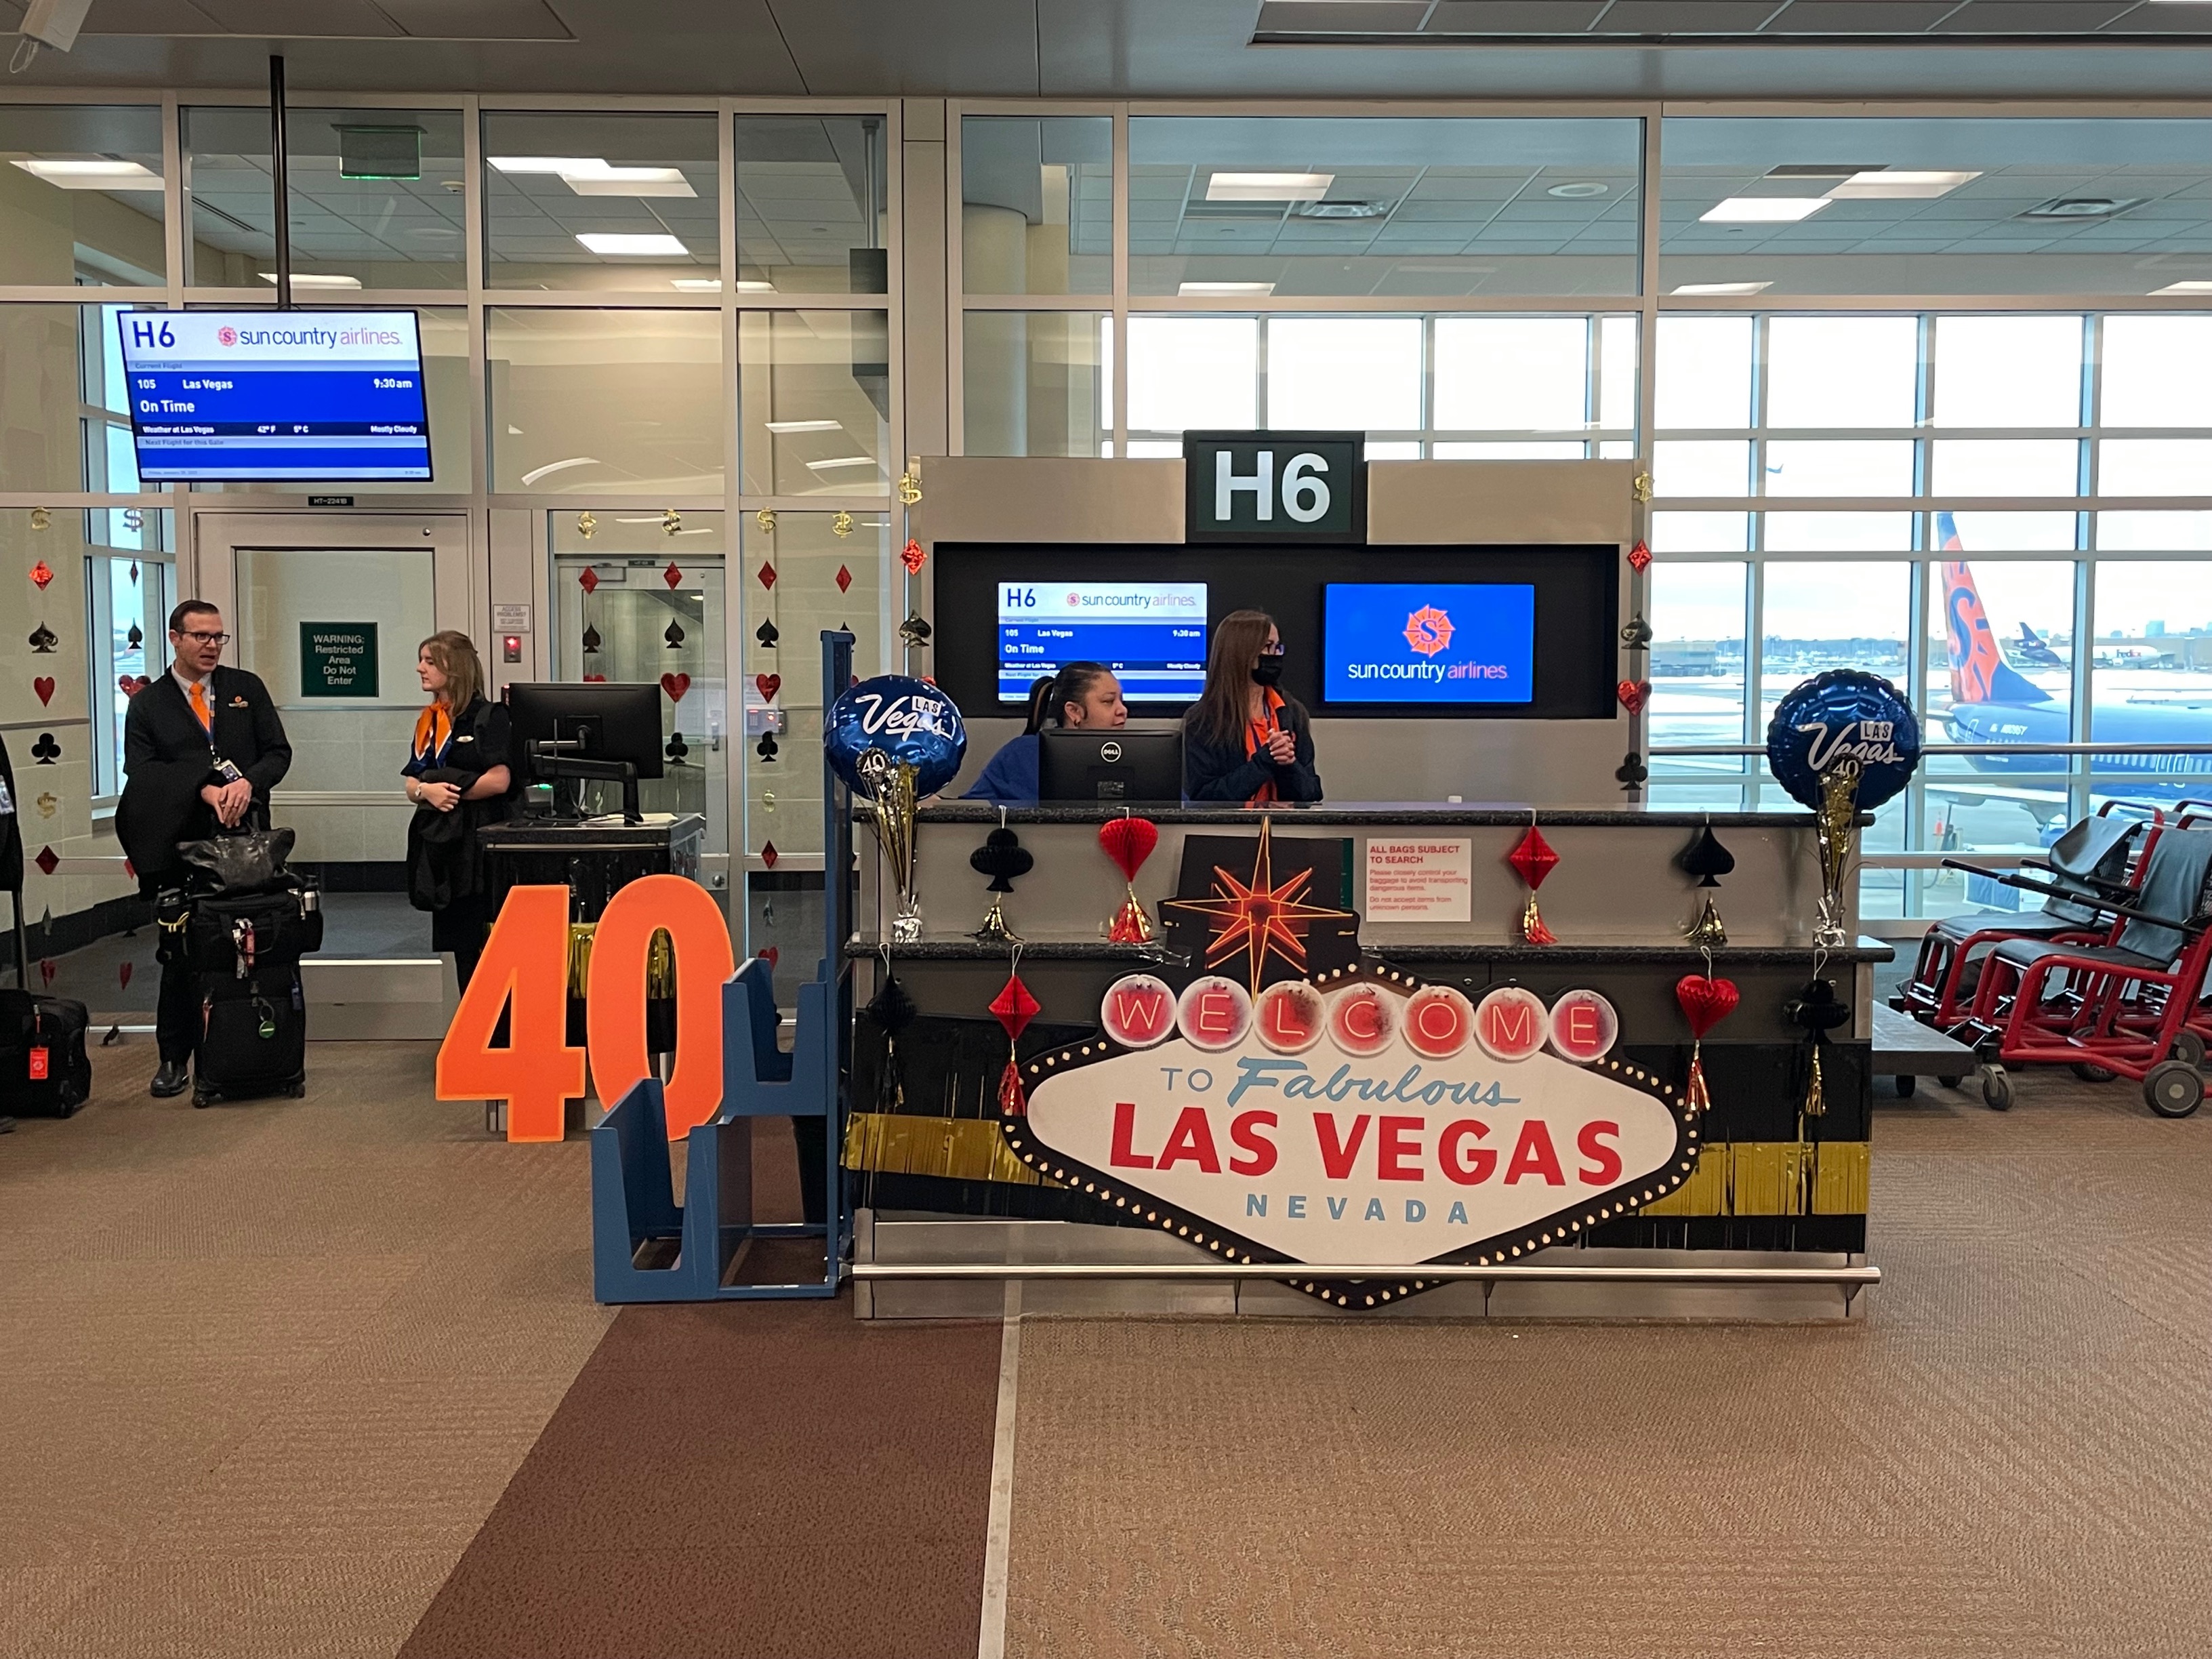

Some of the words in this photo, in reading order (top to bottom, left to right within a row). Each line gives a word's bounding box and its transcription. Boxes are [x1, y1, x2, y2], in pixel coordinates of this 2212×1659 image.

[133, 321, 176, 348] H6
[340, 327, 401, 345] airlines
[137, 379, 157, 390] 105
[182, 379, 201, 389] Las
[202, 379, 233, 391] Vegas
[373, 378, 395, 389] 9:30
[396, 380, 413, 389] am
[140, 400, 159, 413] On
[160, 400, 195, 413] Time
[1215, 450, 1330, 523] H6
[1007, 588, 1036, 607] H6
[313, 634, 365, 644] WARNING:
[1005, 628, 1019, 637] 105
[1037, 629, 1051, 637] Las
[1050, 629, 1073, 638] Vegas
[315, 645, 364, 654] Restricted
[1005, 644, 1019, 653] On
[1019, 643, 1044, 653] Time
[328, 655, 350, 664] Area
[323, 665, 337, 674] Do
[339, 665, 356, 674] Not
[1448, 661, 1507, 679] airlines
[327, 676, 353, 684] Enter
[916, 698, 939, 714] LAS
[855, 694, 953, 742] Vegas
[1864, 723, 1890, 739] LAS
[861, 754, 886, 773] 40
[1832, 759, 1859, 779] 40
[436, 874, 735, 1142] 40
[1117, 994, 1597, 1045] WELCOME
[1160, 1067, 1213, 1092] TO
[1227, 1055, 1521, 1108] Fabulous
[1109, 1102, 1278, 1176] LAS
[1313, 1112, 1623, 1187] VEGAS
[1246, 1193, 1469, 1225] NEVADA
